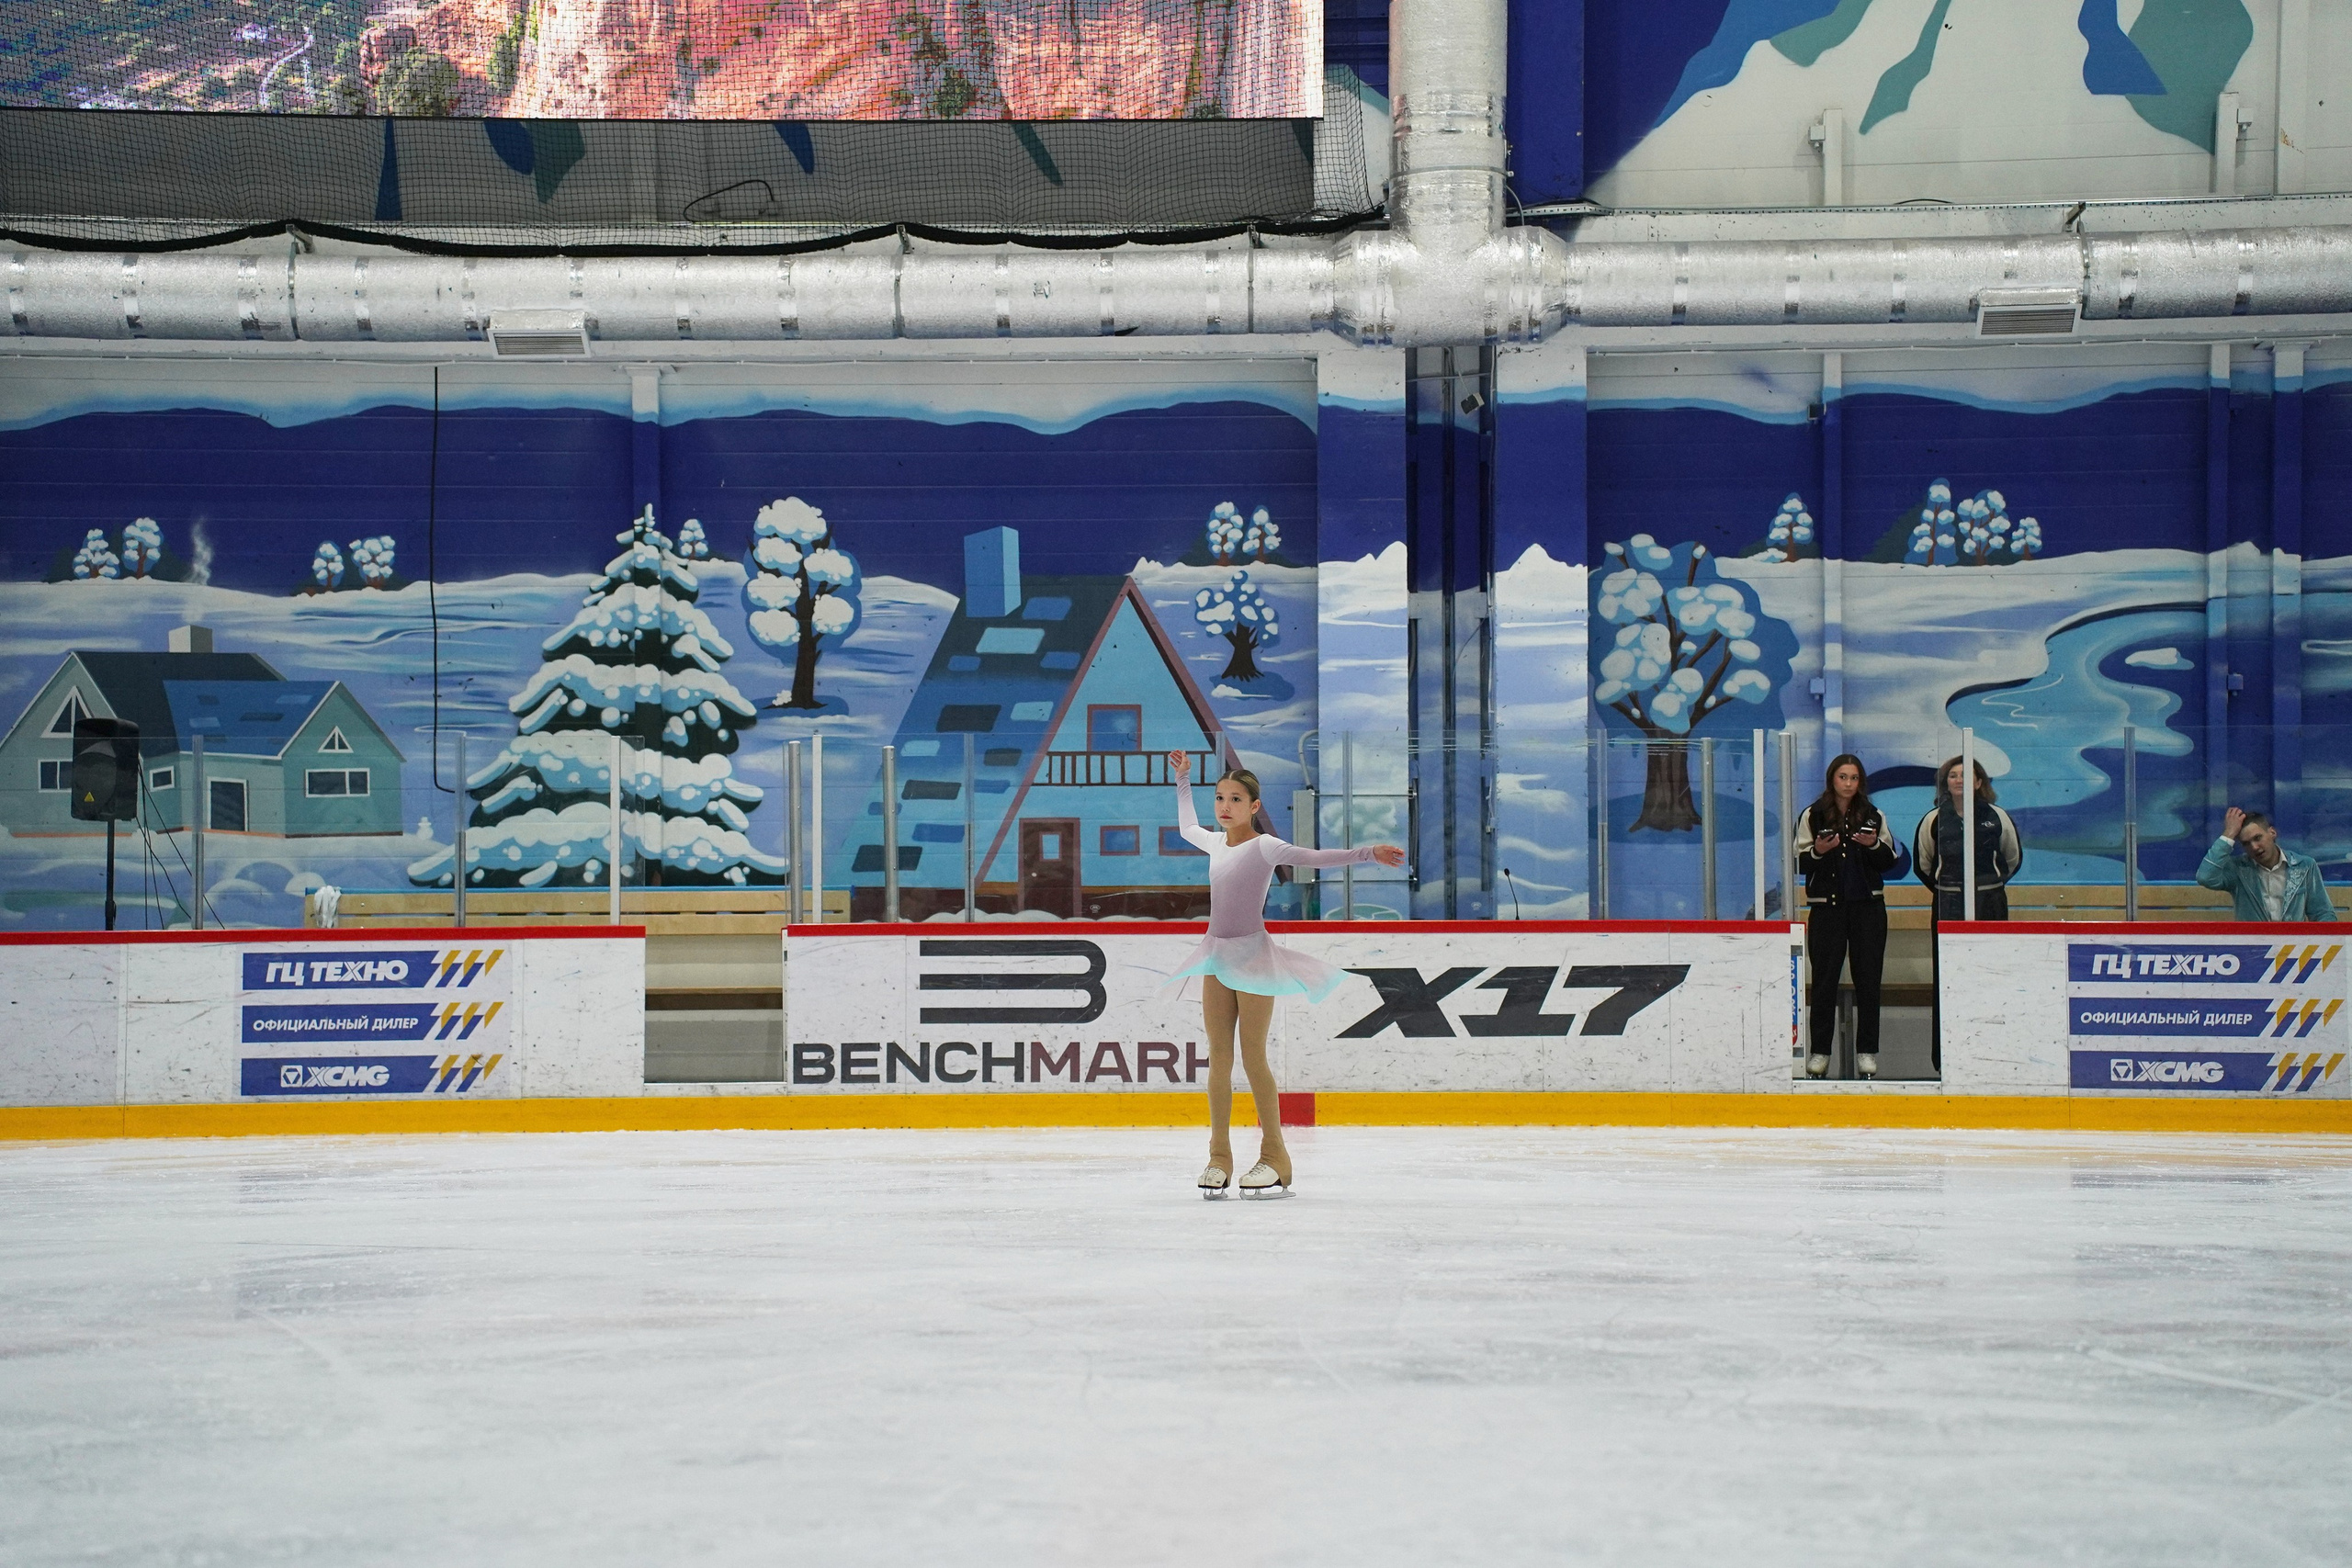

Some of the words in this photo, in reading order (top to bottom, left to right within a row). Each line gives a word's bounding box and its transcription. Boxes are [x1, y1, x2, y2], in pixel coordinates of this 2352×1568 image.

[266, 961, 304, 986] ГЦ
[311, 960, 409, 982] ТЕХНО
[2092, 953, 2132, 979] ГЦ
[2135, 954, 2240, 976] ТЕХНО
[1334, 964, 1691, 1038] X17
[253, 1015, 368, 1031] ОФИЦИАЛЬНЫЙ
[371, 1017, 418, 1031] ДИЛЕР
[2080, 1010, 2199, 1025] ОФИЦИАЛЬНЫЙ
[2203, 1013, 2253, 1026] ДИЛЕР
[302, 1065, 390, 1088] XCMG
[2132, 1061, 2224, 1083] XCMG
